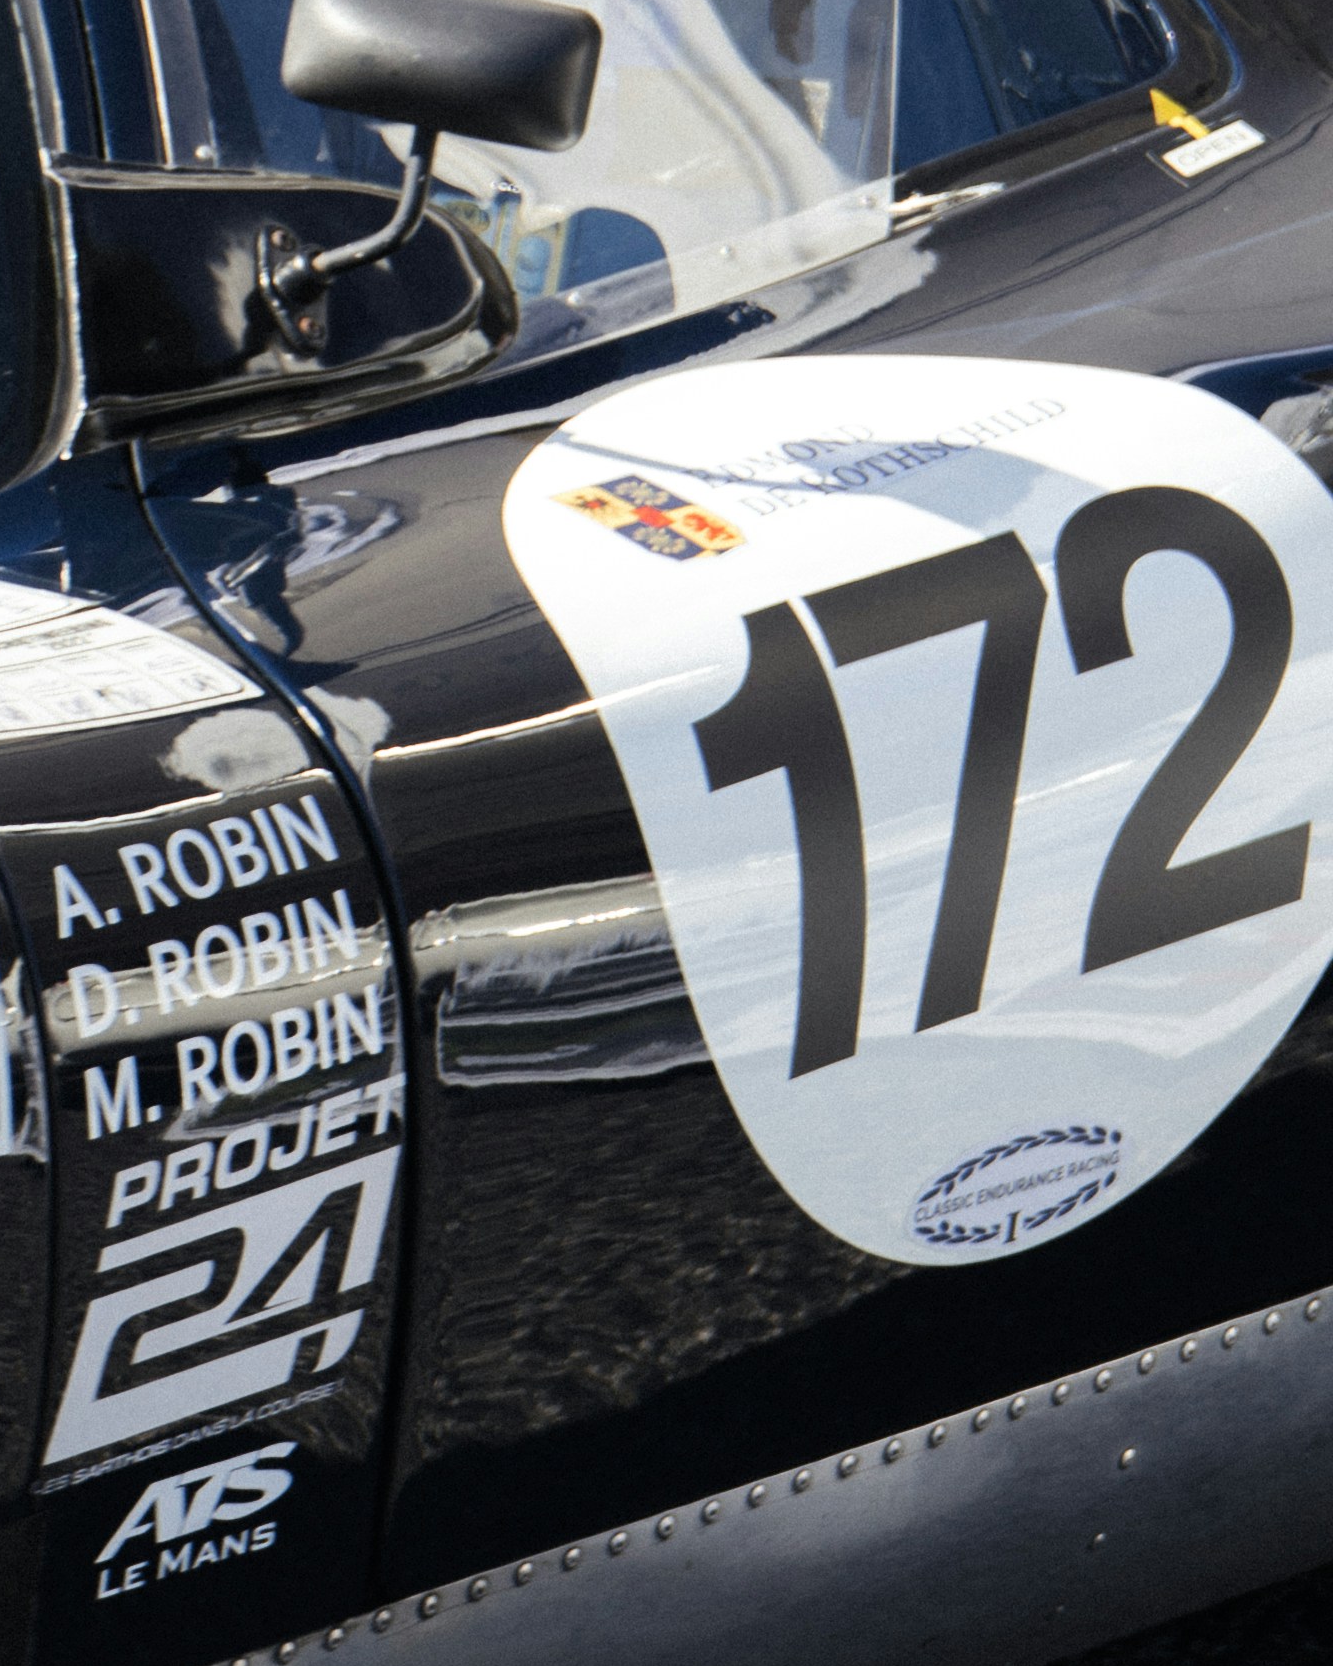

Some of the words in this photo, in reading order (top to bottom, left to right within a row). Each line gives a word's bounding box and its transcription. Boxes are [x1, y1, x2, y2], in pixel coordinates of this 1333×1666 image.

[799, 396, 1068, 495] ROTHSCHILD
[693, 484, 1312, 1082] 172
[52, 864, 122, 940] A.
[118, 794, 340, 915] ROBIN
[66, 963, 141, 1040] D.
[147, 888, 362, 1016] ROBIN
[83, 1055, 164, 1141] M.
[176, 983, 386, 1113] ROBIN
[105, 1072, 407, 1230] PROJET
[914, 1191, 974, 1224] CLASSIC
[976, 1164, 1066, 1206] ENDURANCE
[1065, 1148, 1121, 1177] RACING
[55, 1151, 399, 1453] 24
[93, 1440, 299, 1565] ATS
[95, 1561, 150, 1601] LE
[155, 1520, 278, 1582] MANS
